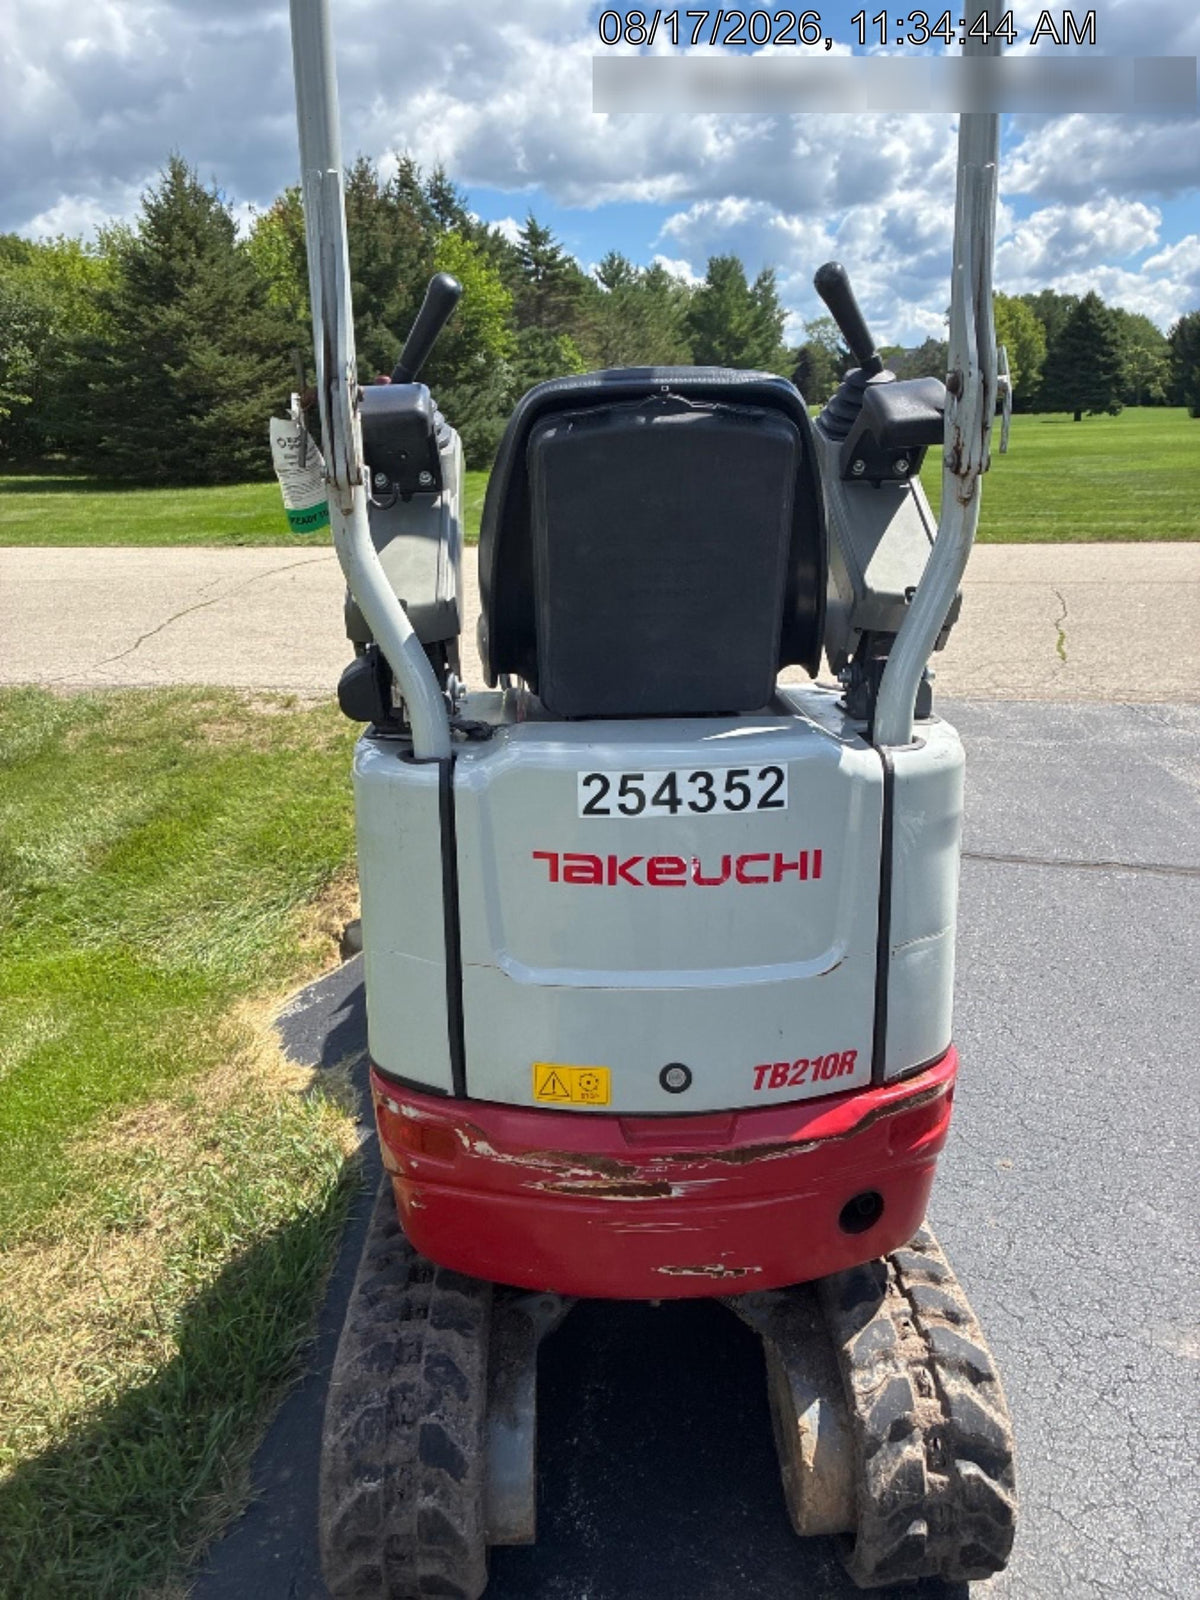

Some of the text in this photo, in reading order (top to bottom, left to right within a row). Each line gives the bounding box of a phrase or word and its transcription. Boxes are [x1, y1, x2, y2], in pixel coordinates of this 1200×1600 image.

[582, 765, 785, 816] 254352
[532, 849, 823, 887] TAKEUCHI
[753, 1049, 858, 1091] TB210R
